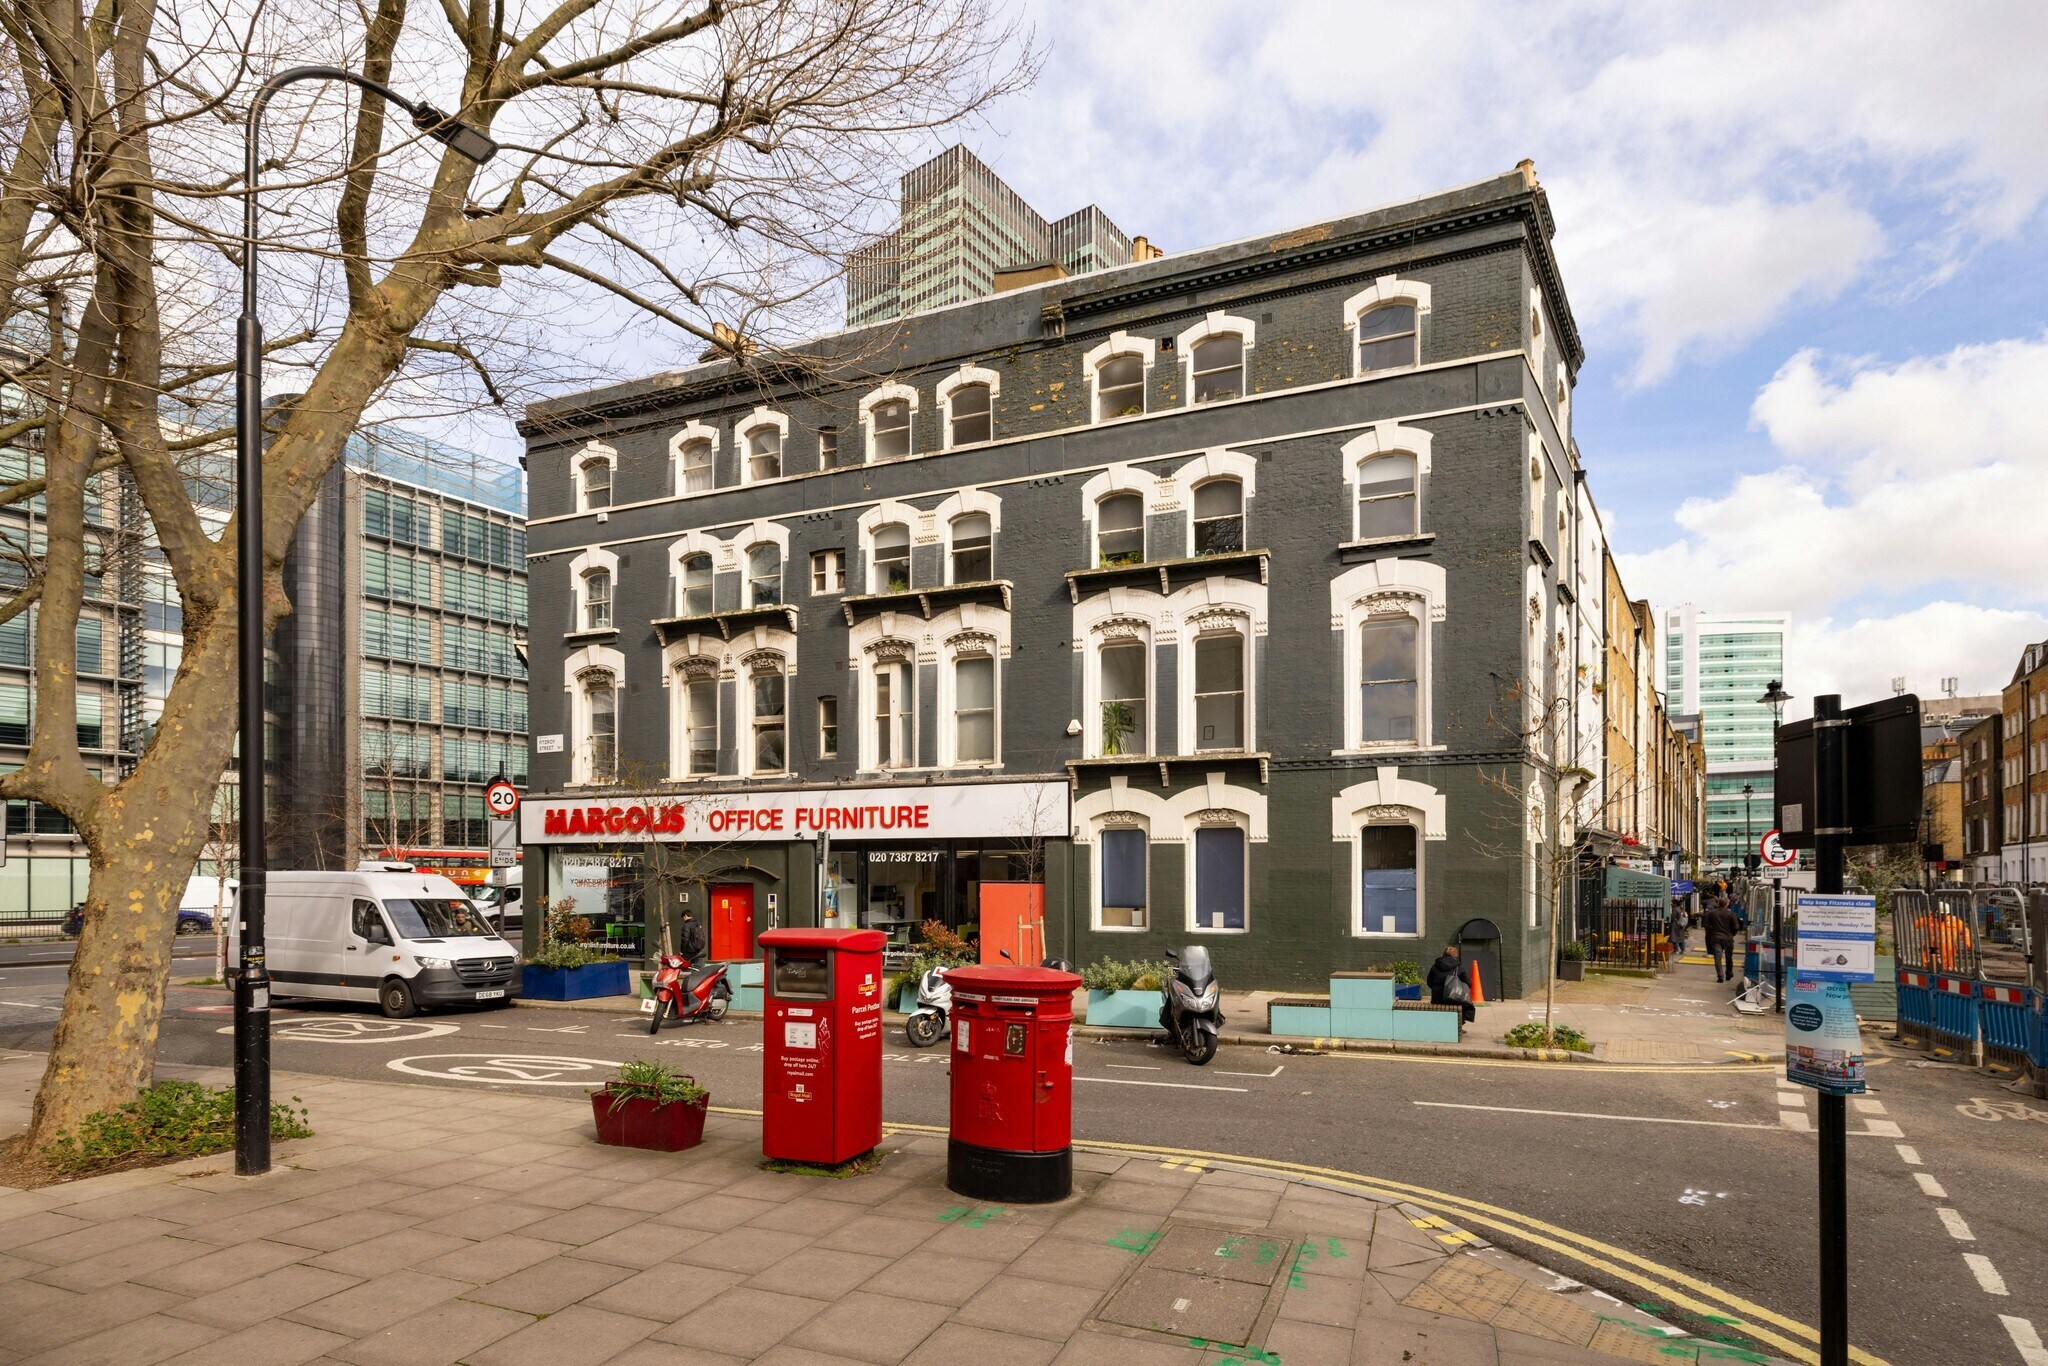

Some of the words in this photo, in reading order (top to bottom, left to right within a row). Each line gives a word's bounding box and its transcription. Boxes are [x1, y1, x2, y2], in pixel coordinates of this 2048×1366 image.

[492, 792, 514, 805] 20
[544, 805, 686, 835] MARGOLIS
[708, 808, 784, 832] OFFICE
[795, 805, 929, 831] FURNITURE
[562, 857, 580, 867] 020
[583, 857, 606, 867] 7387
[609, 857, 633, 867] 8217
[869, 853, 887, 862] 020
[889, 852, 912, 862] 7387
[915, 852, 939, 862] 8217
[1794, 981, 1816, 989] CAMDEN
[852, 1005, 866, 1014] Parcel
[448, 1058, 593, 1080] 20
